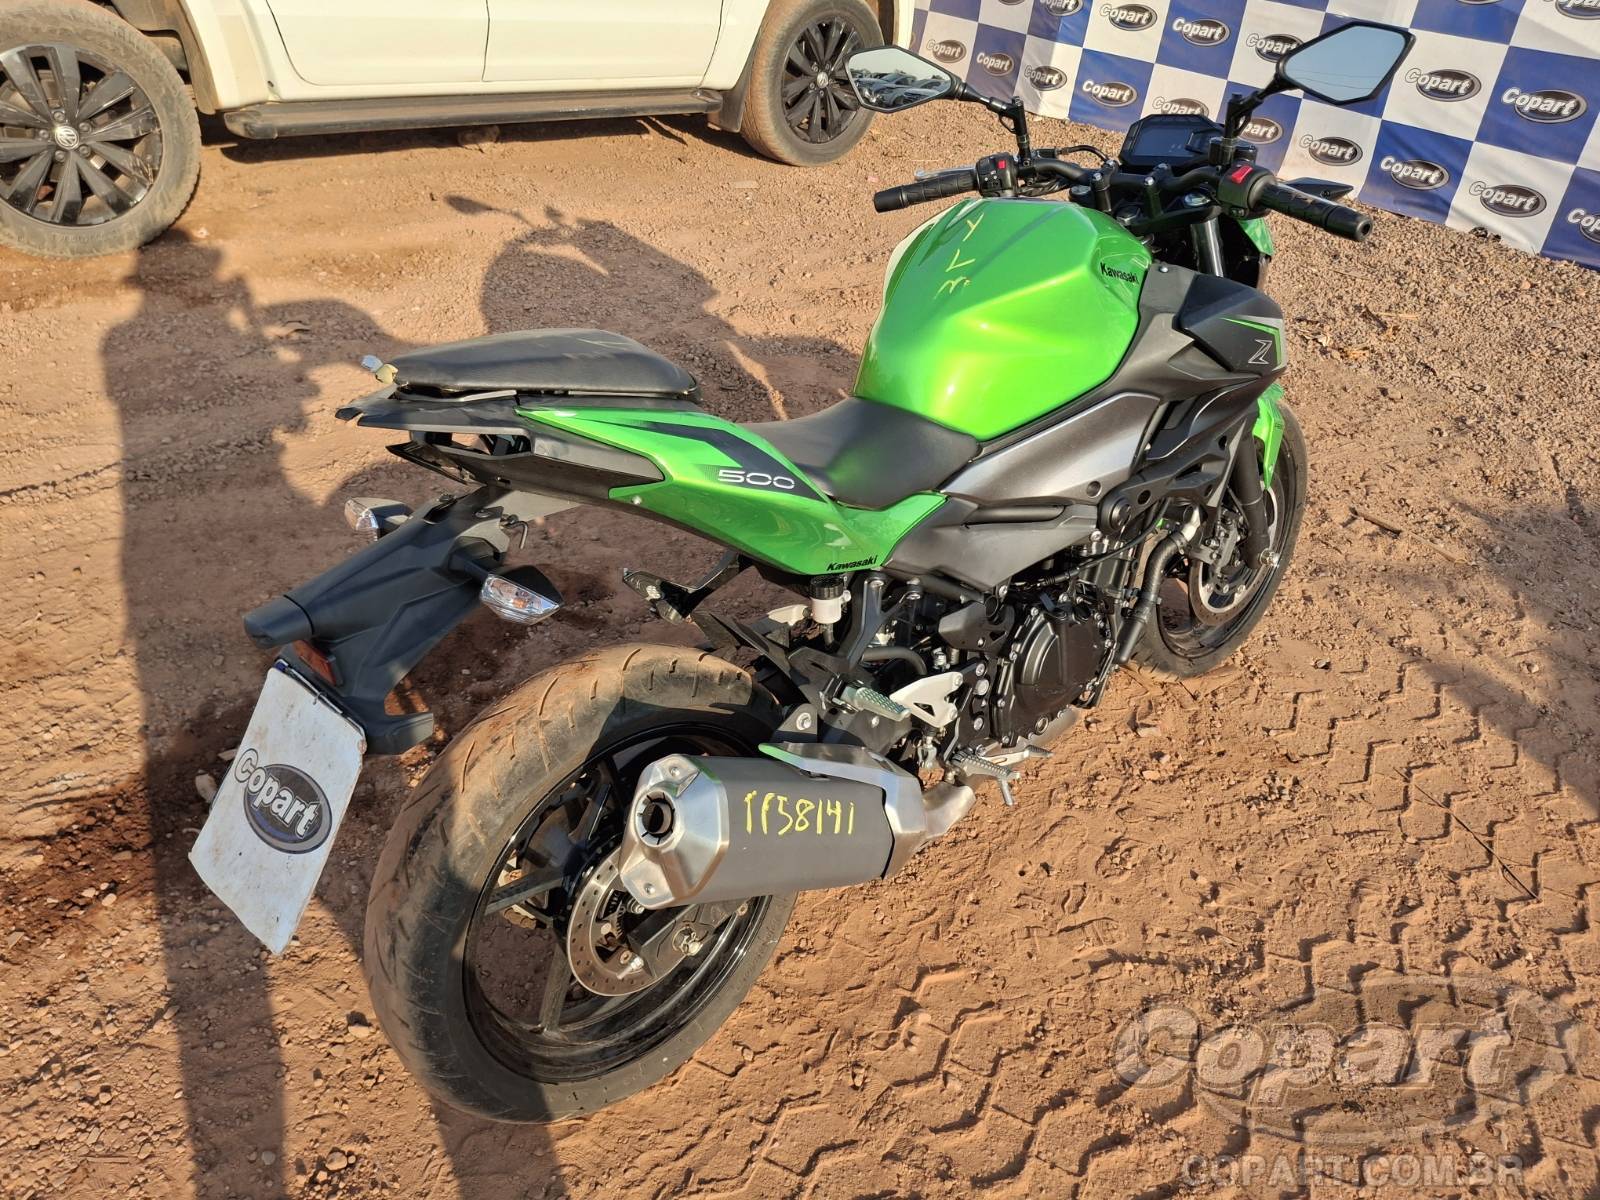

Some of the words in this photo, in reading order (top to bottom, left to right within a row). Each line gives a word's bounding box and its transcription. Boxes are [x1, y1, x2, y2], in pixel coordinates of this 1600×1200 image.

[1100, 4, 1150, 25] Copart
[1172, 18, 1223, 40] Copart
[926, 39, 961, 57] Copart
[976, 52, 1010, 71] Copart
[1024, 65, 1059, 85] Copart
[1404, 68, 1471, 95] Copart
[1082, 80, 1131, 102] Copart
[1502, 87, 1579, 116] Copart
[1299, 134, 1356, 161] Copart
[1380, 156, 1440, 185] Copart
[1469, 181, 1538, 212] Copart
[1100, 262, 1139, 284] Kawasaki
[1247, 339, 1273, 364] Z
[717, 469, 795, 490] 500
[826, 555, 878, 572] Kawasaki
[234, 748, 320, 838] Copart
